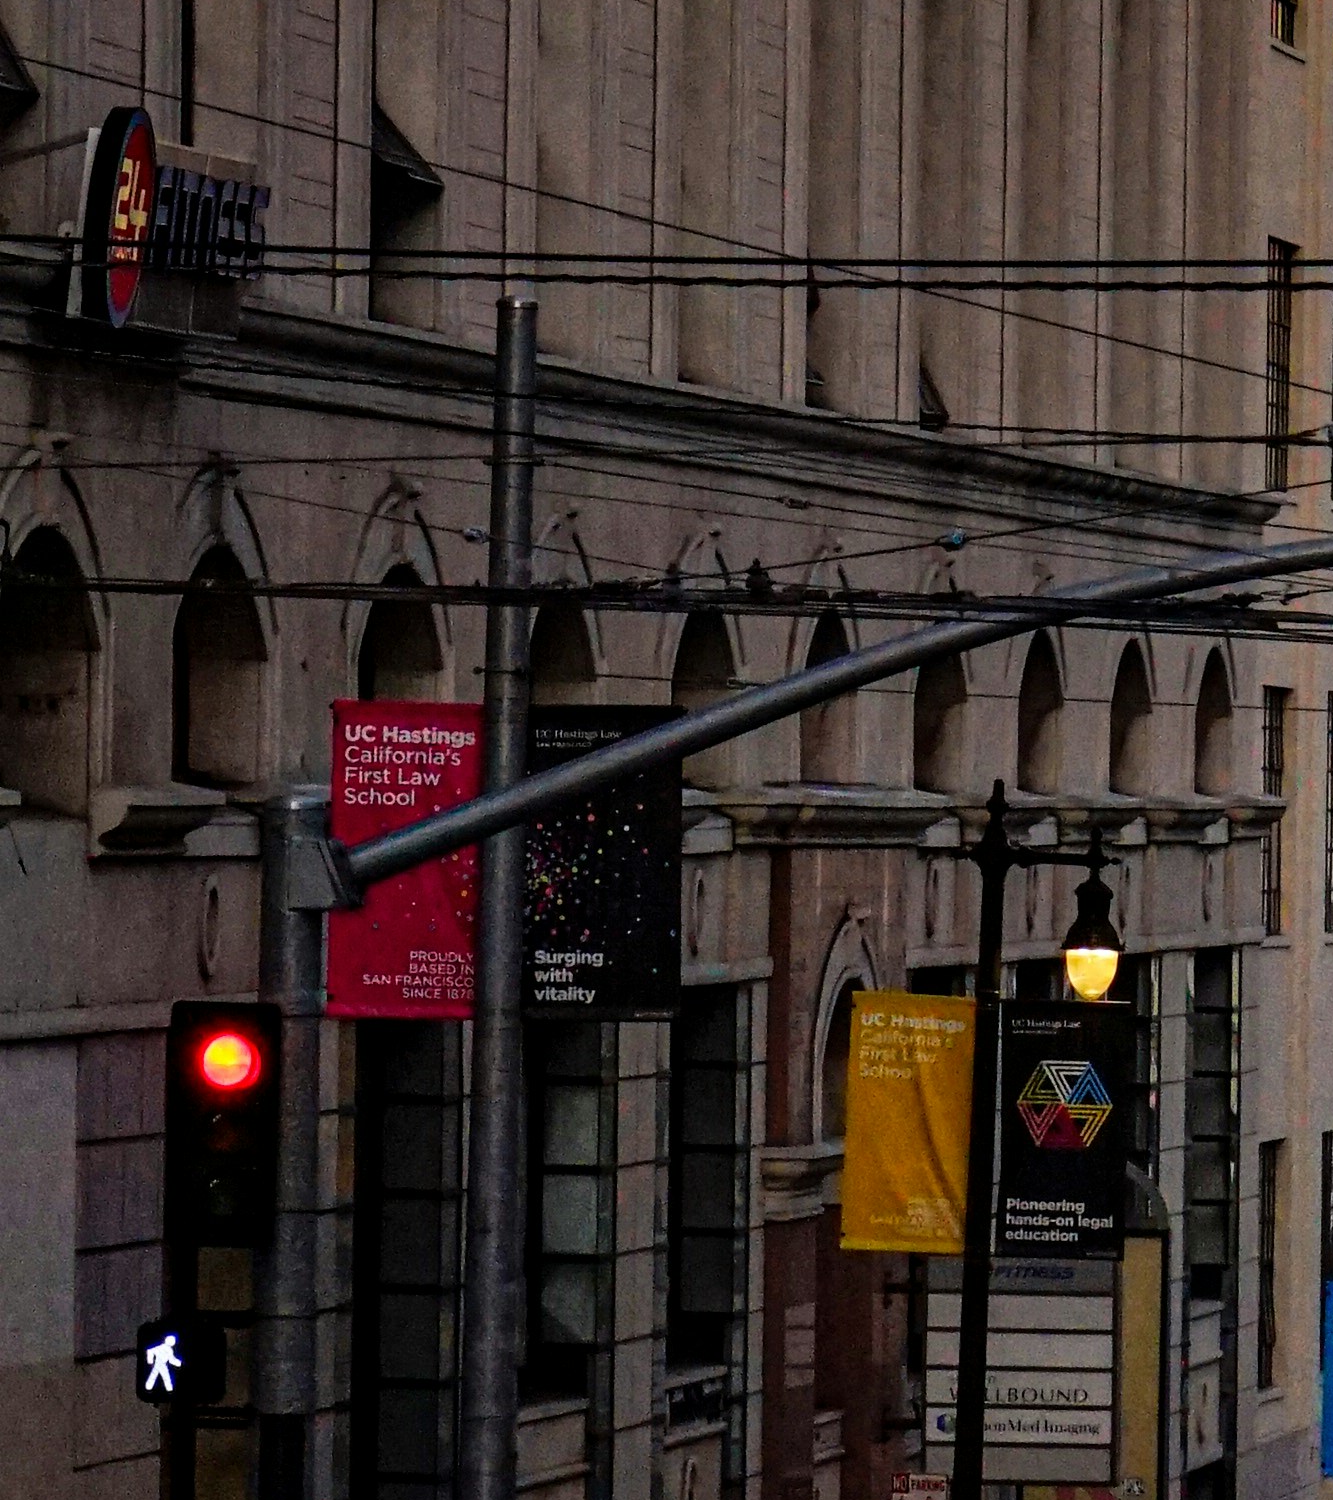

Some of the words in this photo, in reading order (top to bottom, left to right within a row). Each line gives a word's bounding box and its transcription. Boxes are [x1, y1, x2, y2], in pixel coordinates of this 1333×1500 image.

[115, 158, 148, 241] 24
[345, 725, 377, 742] UC
[383, 726, 477, 747] Hastings
[344, 746, 461, 767] California's
[345, 767, 391, 785] First
[398, 767, 441, 786] Law
[344, 788, 416, 806] School
[410, 951, 474, 963] PROUDLY
[534, 950, 604, 967] Surging
[410, 963, 457, 975] BASED
[461, 964, 475, 975] IN
[534, 967, 573, 982] with
[363, 974, 392, 985] SAN
[395, 975, 475, 987] FRANCISCO
[402, 988, 442, 1000] SINCE
[534, 987, 596, 1004] vitality
[1006, 1197, 1085, 1215] Pioneering
[1005, 1213, 1074, 1228] hands-on
[1077, 1213, 1114, 1231] legal
[1004, 1228, 1079, 1243] education
